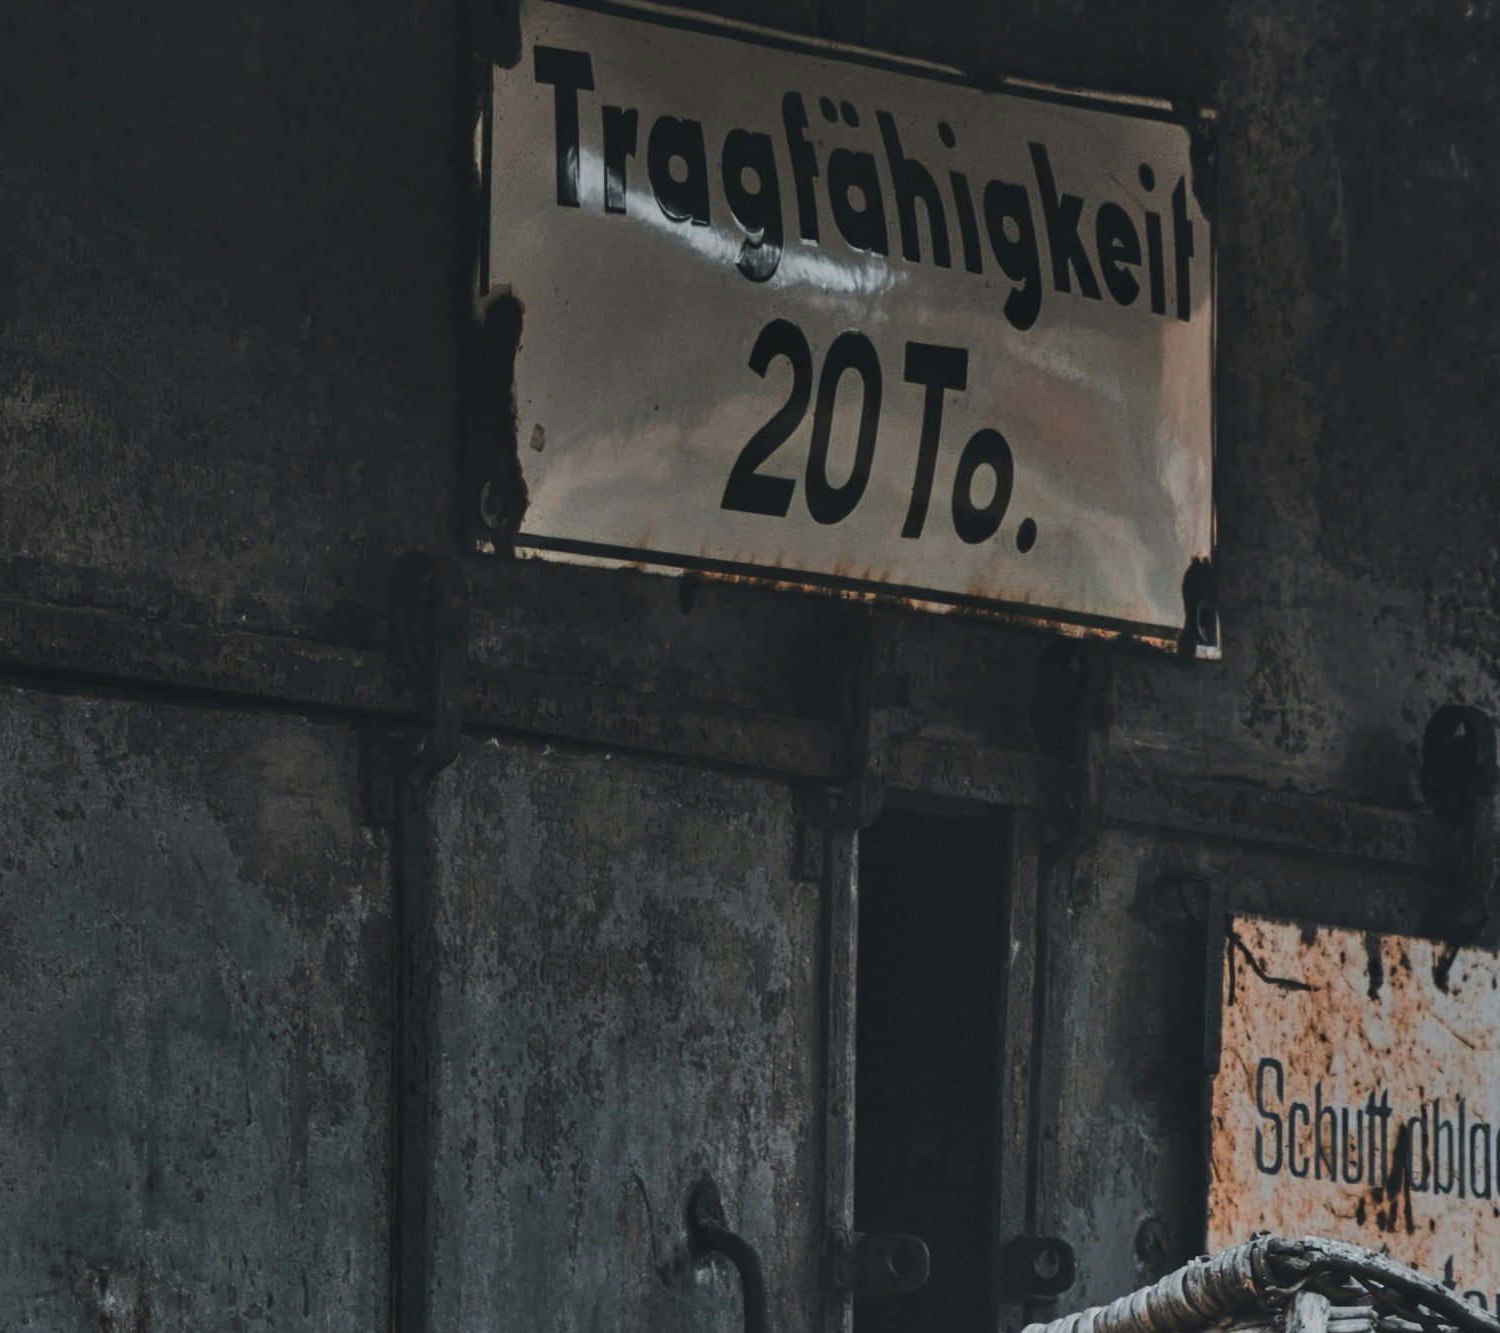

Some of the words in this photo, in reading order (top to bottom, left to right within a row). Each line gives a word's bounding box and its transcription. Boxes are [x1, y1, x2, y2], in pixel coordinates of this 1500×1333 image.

[533, 47, 1195, 331] Tragfähigkeit
[720, 319, 884, 526] 20
[901, 342, 1040, 554] To.
